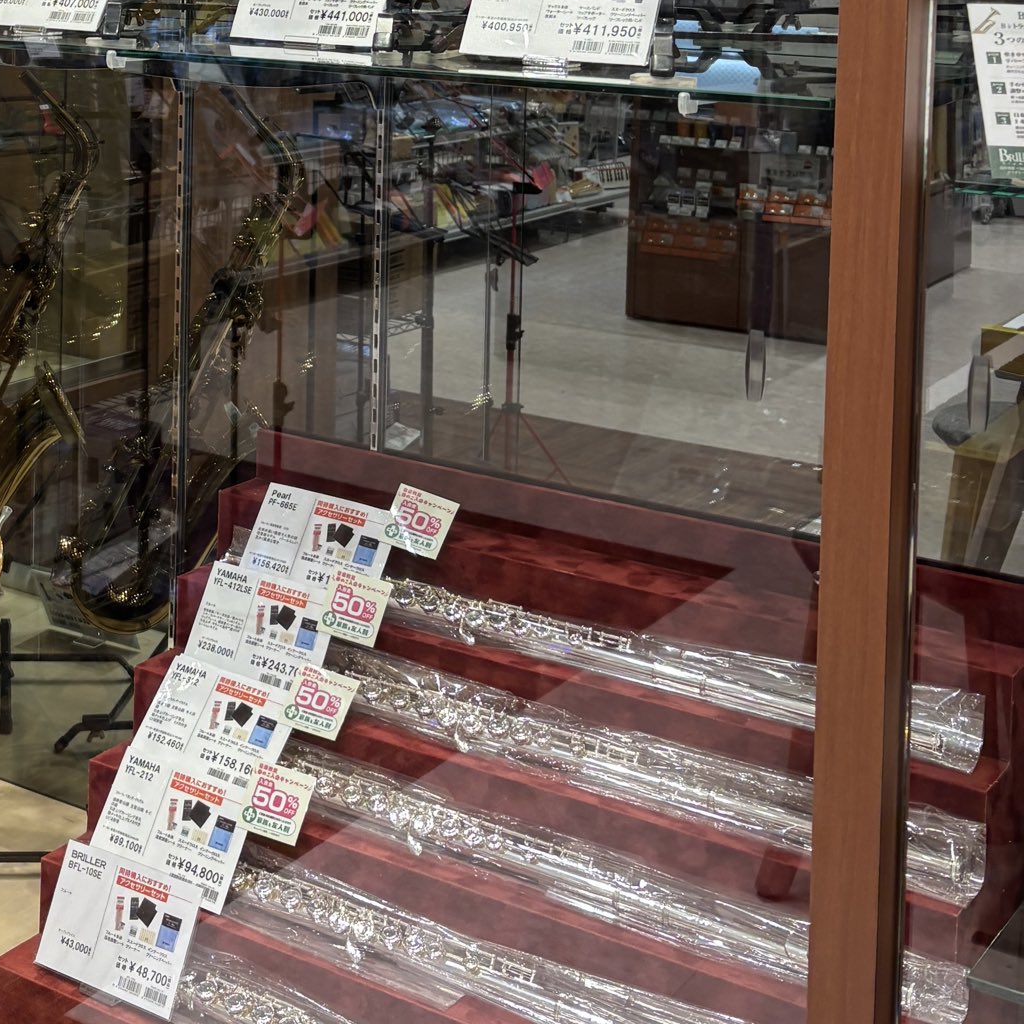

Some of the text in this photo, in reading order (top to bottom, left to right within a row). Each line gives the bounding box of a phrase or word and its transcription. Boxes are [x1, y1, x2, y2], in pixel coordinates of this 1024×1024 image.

[321, 9, 369, 22] ¥441,000
[481, 21, 528, 32] ¥400,950
[574, 23, 637, 37] ¥411,950
[271, 490, 291, 500] Pearl
[268, 498, 298, 511] PF-665E
[317, 508, 363, 524] アクセサリーセット
[217, 568, 248, 584] YAMAHA
[213, 577, 252, 595] YFL-412LSE
[260, 589, 304, 606] アクセサリーセット
[219, 685, 263, 704] アクセサリーセット
[125, 764, 154, 782] YFL-212
[129, 755, 161, 773] YAMAHA
[173, 781, 220, 803] アクセサリーセット
[174, 771, 227, 796] 同時購入におすすめ!
[109, 833, 139, 853] ¥89,100
[71, 850, 106, 869] BRILLER
[68, 860, 102, 879] BFL-10SE
[177, 857, 219, 884] ¥94,800
[119, 866, 172, 892] 同時購入におすすめ!
[118, 878, 166, 901] アクセサリーセット
[60, 936, 88, 954] ¥43,000
[118, 955, 128, 963] セット
